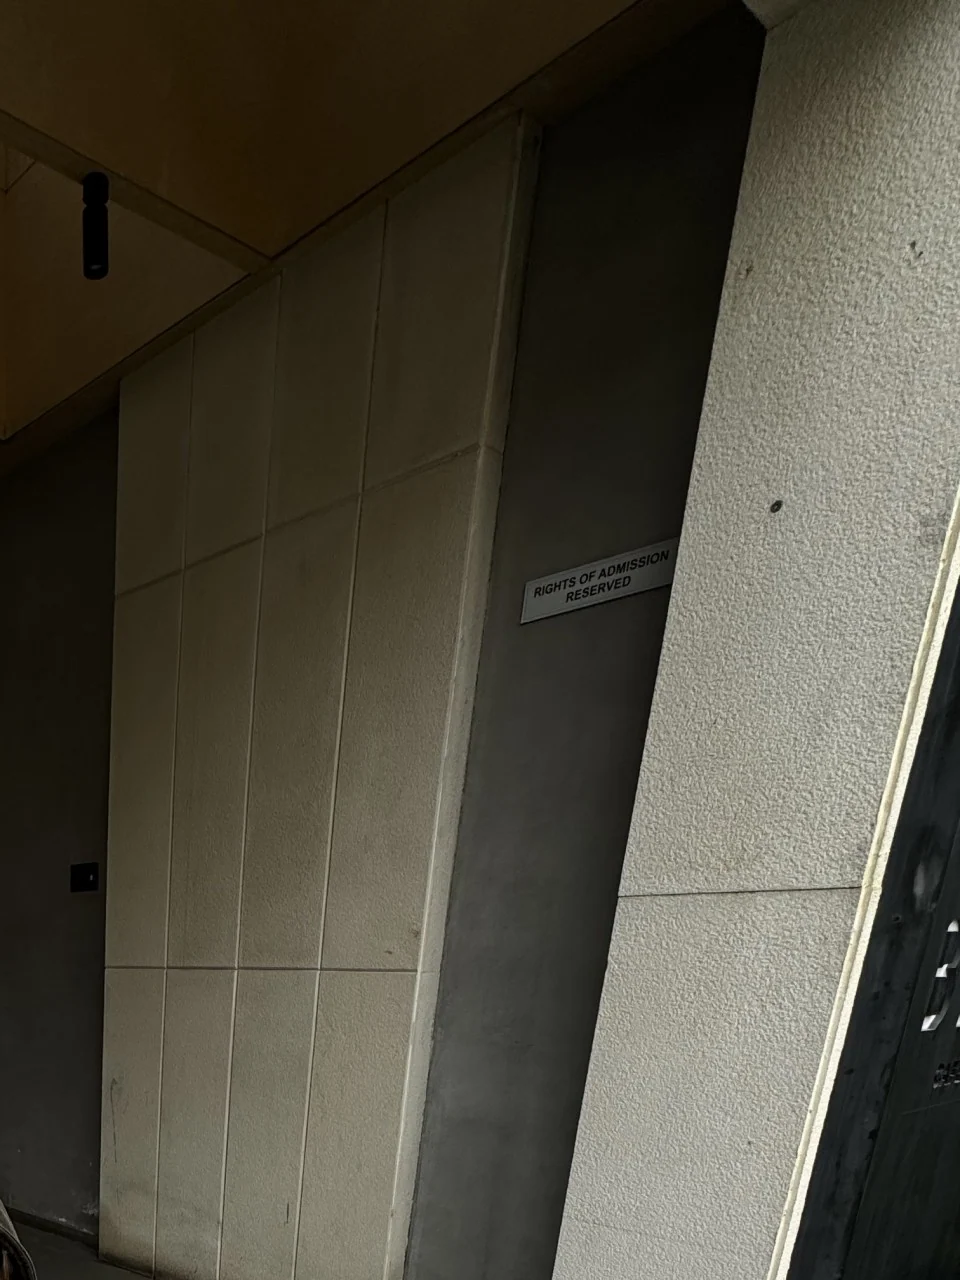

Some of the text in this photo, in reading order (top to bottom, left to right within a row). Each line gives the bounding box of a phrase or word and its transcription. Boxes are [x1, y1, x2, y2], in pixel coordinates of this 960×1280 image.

[533, 551, 670, 598] RIGHTS OF ADMISSION
[566, 576, 632, 603] RESERVED
